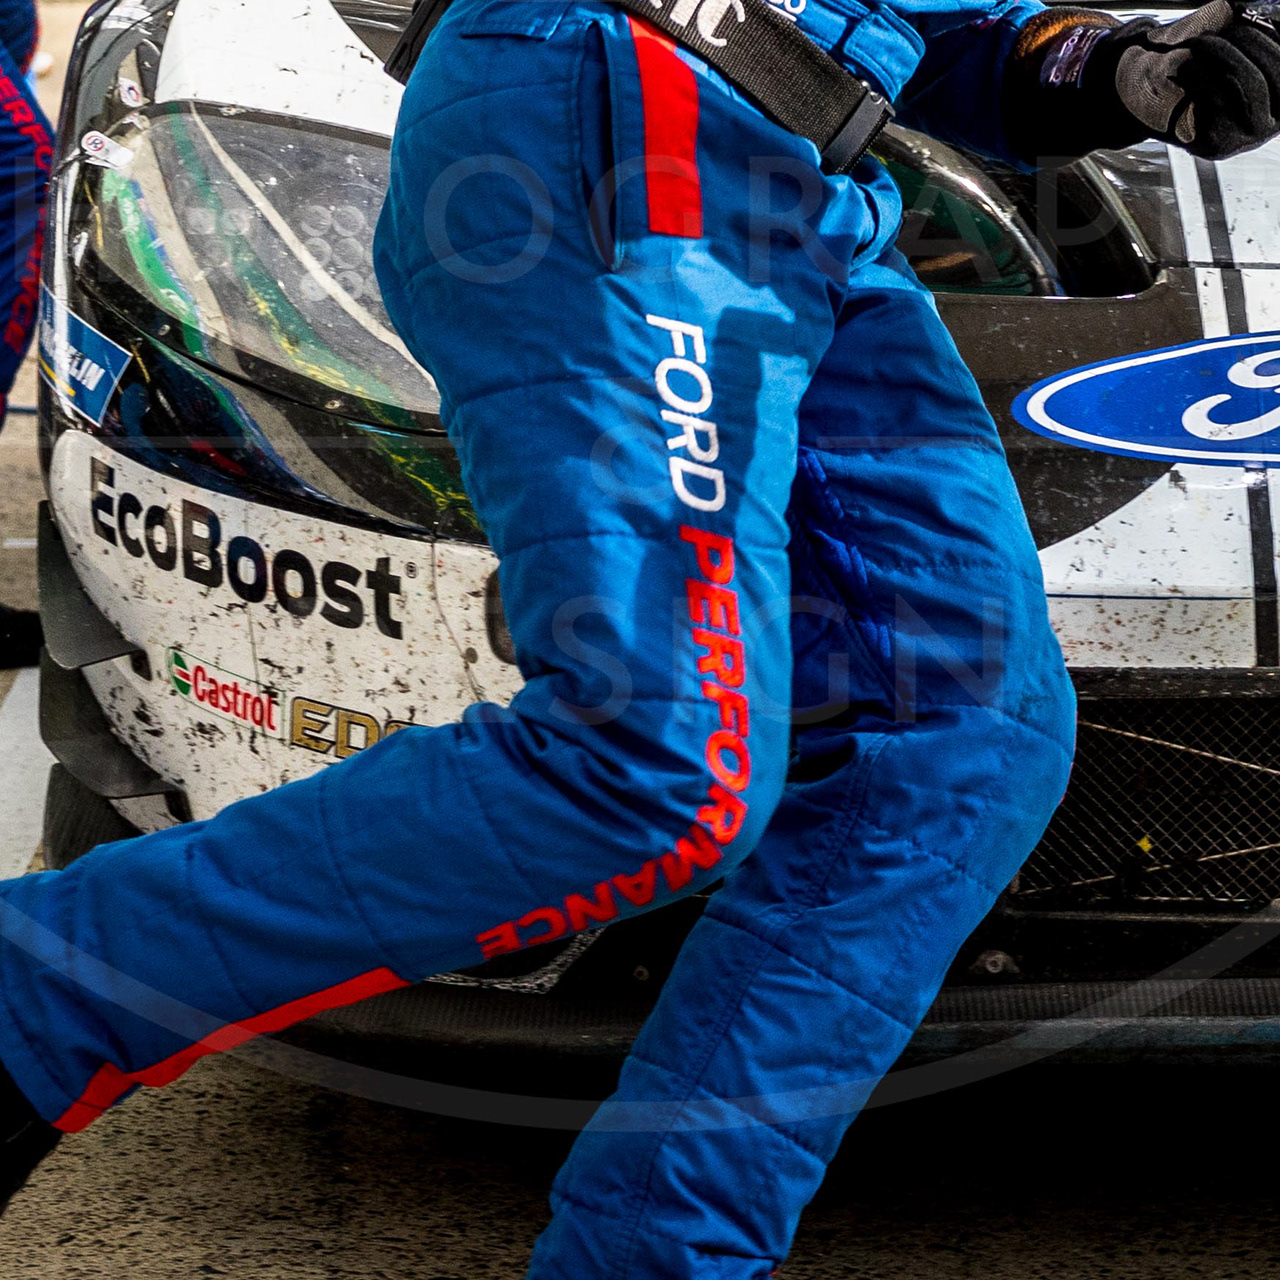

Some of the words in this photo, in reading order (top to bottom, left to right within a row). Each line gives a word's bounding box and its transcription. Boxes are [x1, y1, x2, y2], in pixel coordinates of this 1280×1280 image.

[645, 313, 727, 513] FORD
[90, 456, 404, 641] EcoBoost
[192, 664, 277, 732] Castrol
[475, 524, 749, 960] PERFORMANCE
